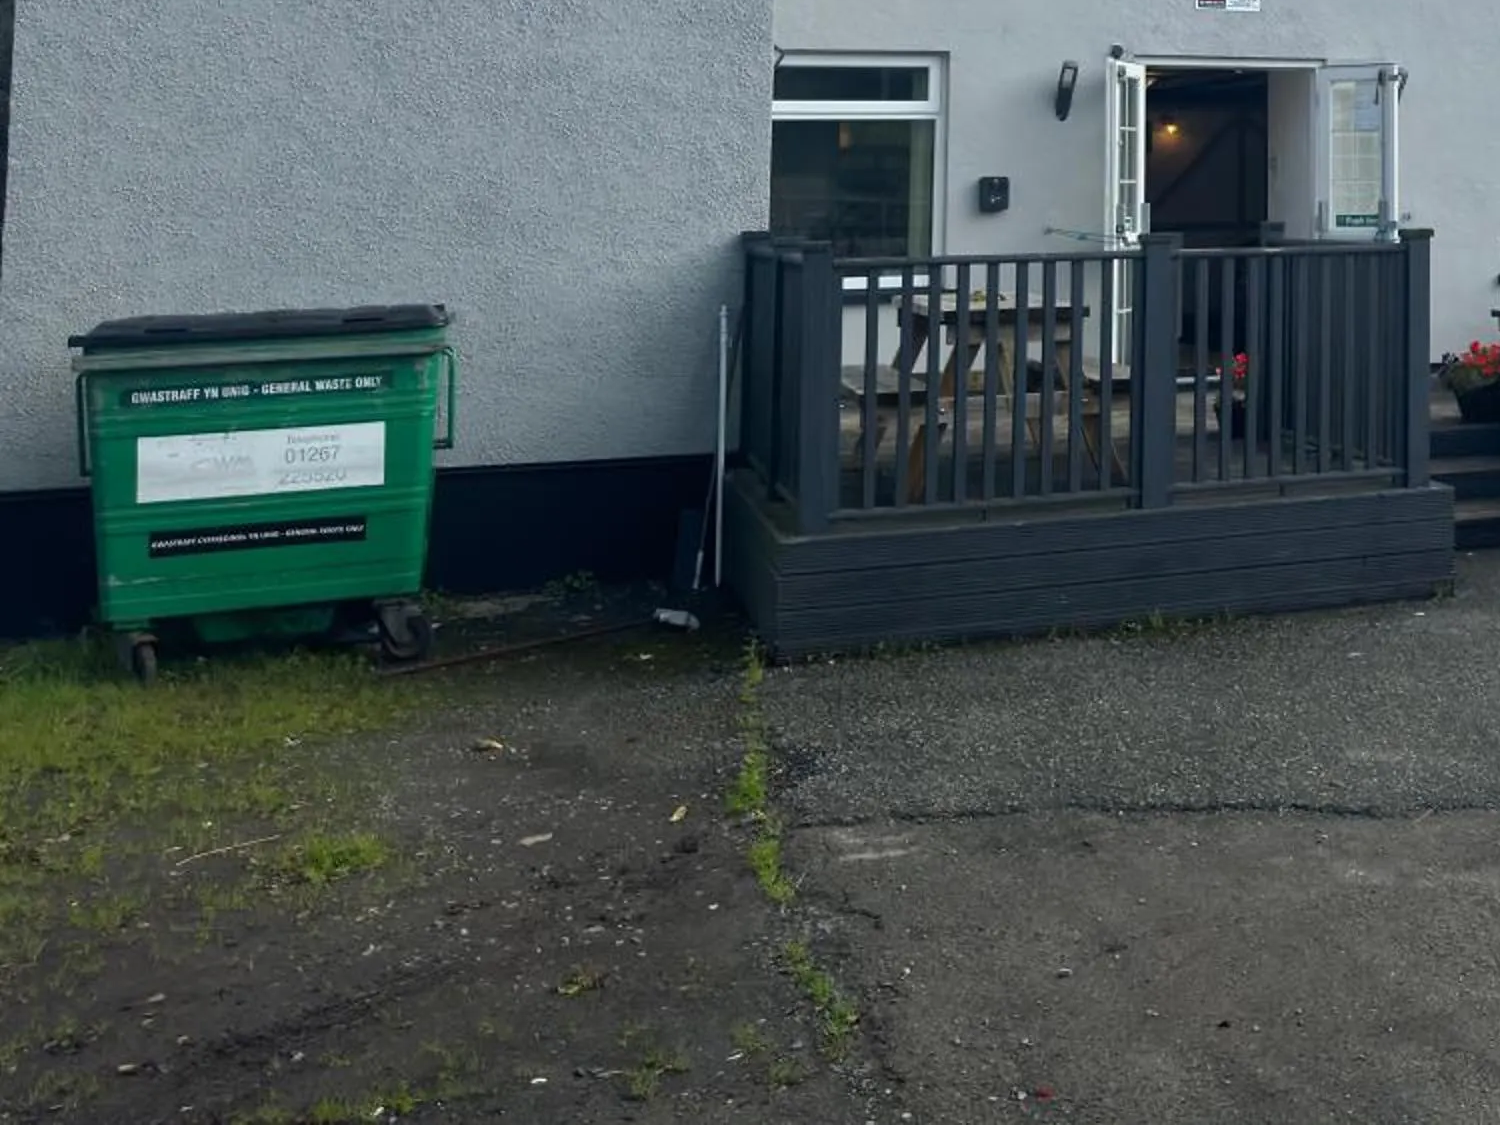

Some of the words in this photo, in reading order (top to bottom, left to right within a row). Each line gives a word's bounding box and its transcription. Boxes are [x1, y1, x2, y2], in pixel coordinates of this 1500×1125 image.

[131, 389, 200, 404] GWASTRAFF
[203, 387, 218, 399] YN
[261, 381, 311, 395] GENERAL
[315, 378, 351, 391] WASTE
[355, 376, 382, 388] ONLY
[285, 445, 341, 463] 01267
